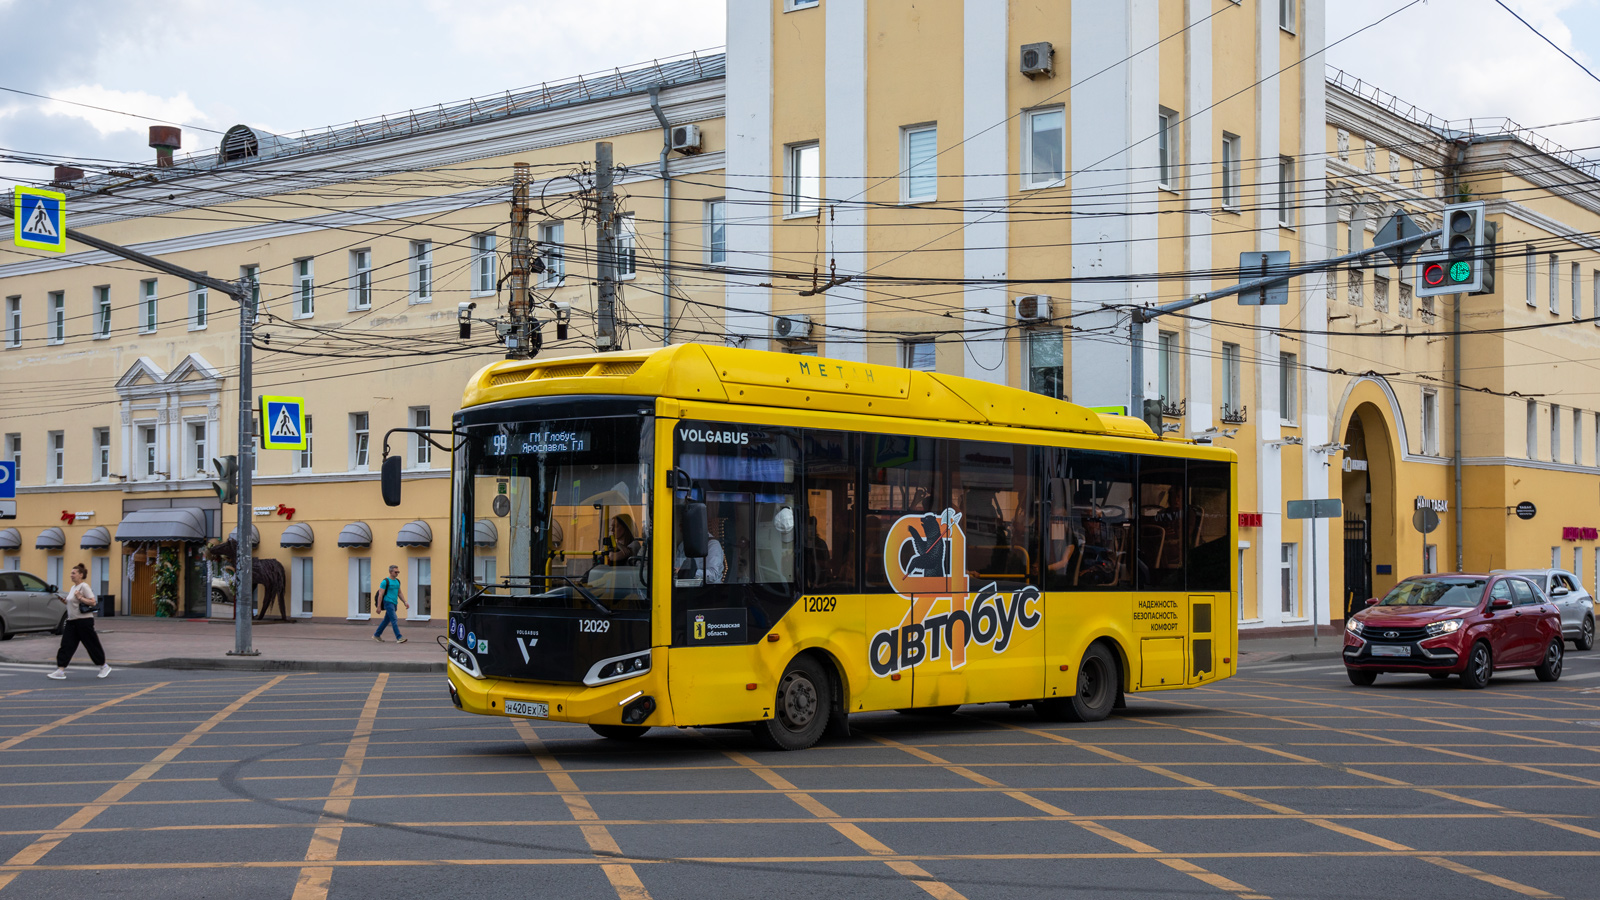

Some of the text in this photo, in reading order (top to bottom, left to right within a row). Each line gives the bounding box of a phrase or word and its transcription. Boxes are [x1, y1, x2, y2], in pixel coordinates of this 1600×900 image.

[529, 431, 576, 442] ГМ Глобус
[680, 428, 749, 445] VOLGABUS
[493, 434, 507, 455] 99
[522, 440, 584, 453] Ярославль ГЛ
[803, 596, 837, 612] 12029
[579, 619, 610, 632] 12029
[870, 582, 1041, 677] автобус
[1150, 623, 1178, 631] КОМФОРТ
